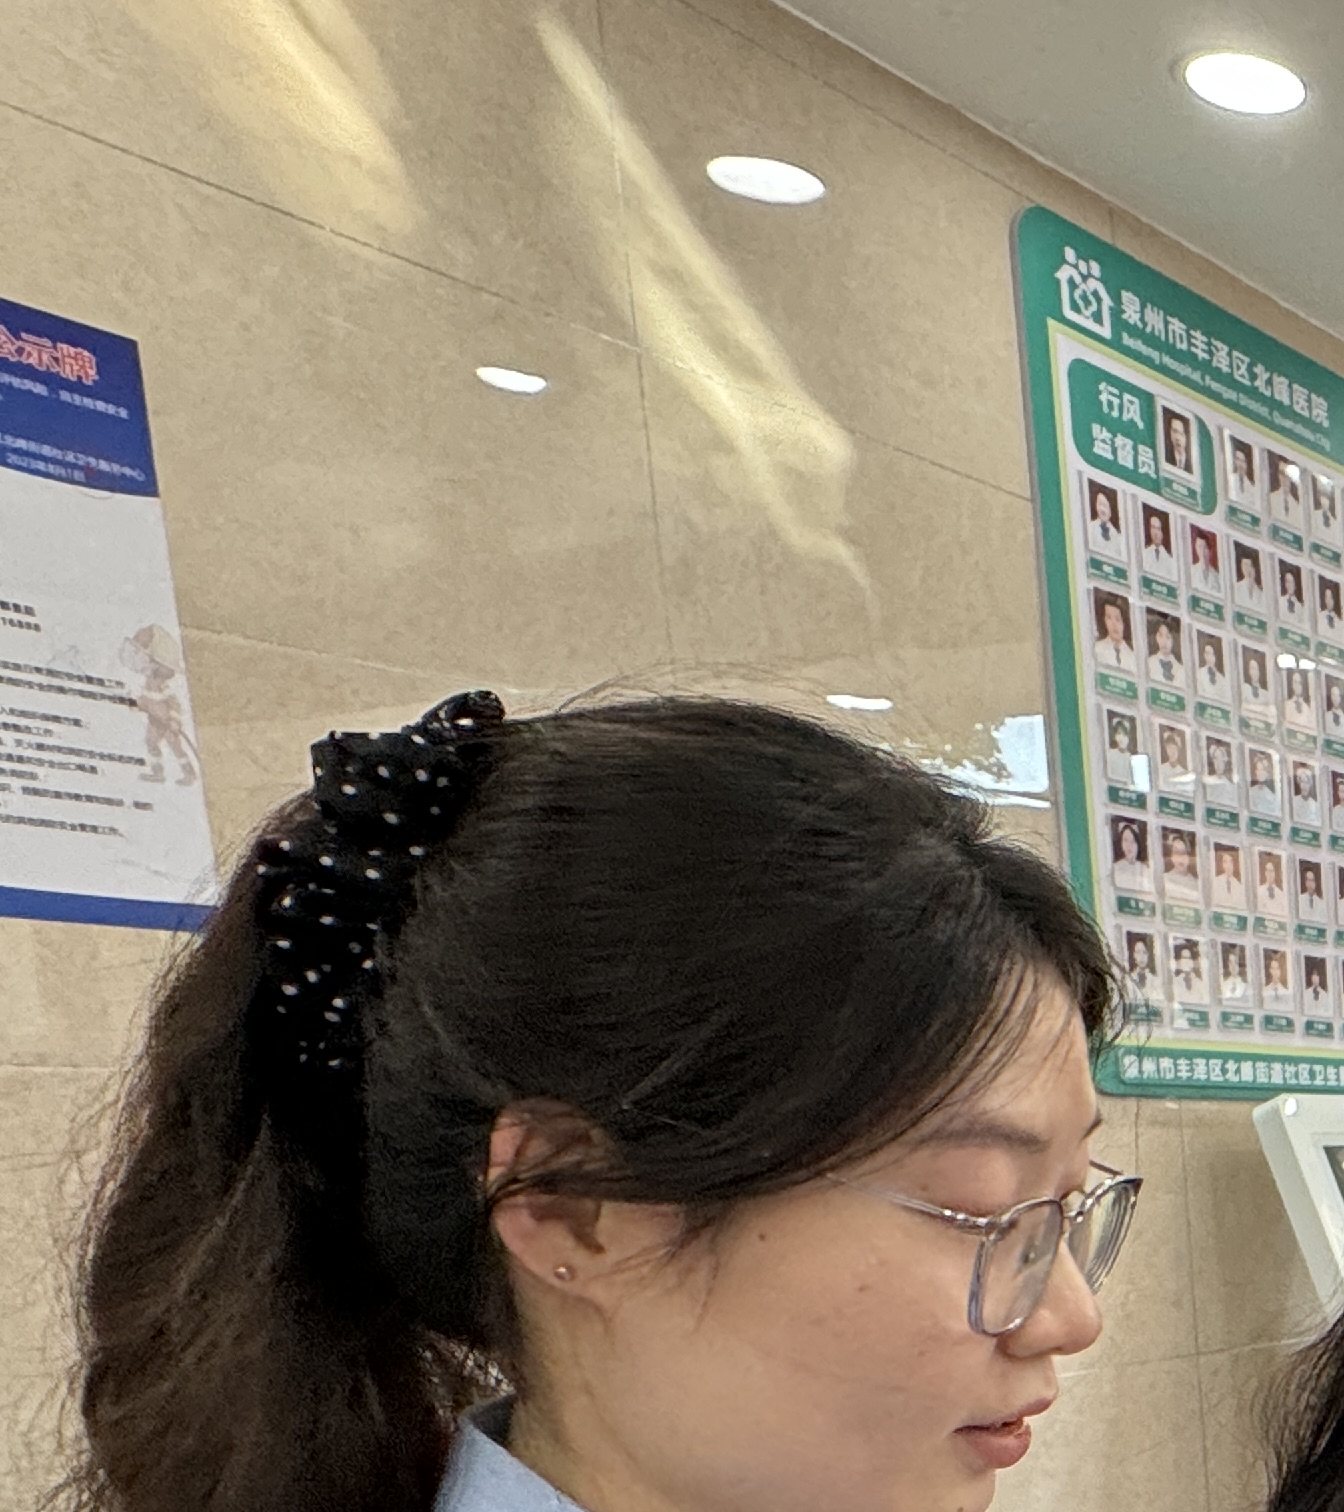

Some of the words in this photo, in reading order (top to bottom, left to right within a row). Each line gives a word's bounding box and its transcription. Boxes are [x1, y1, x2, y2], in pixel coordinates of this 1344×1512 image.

[1120, 289, 1330, 428] 泉州市丰泽区北峰医院
[1098, 381, 1144, 429] 行风
[1091, 422, 1157, 479] 监督员
